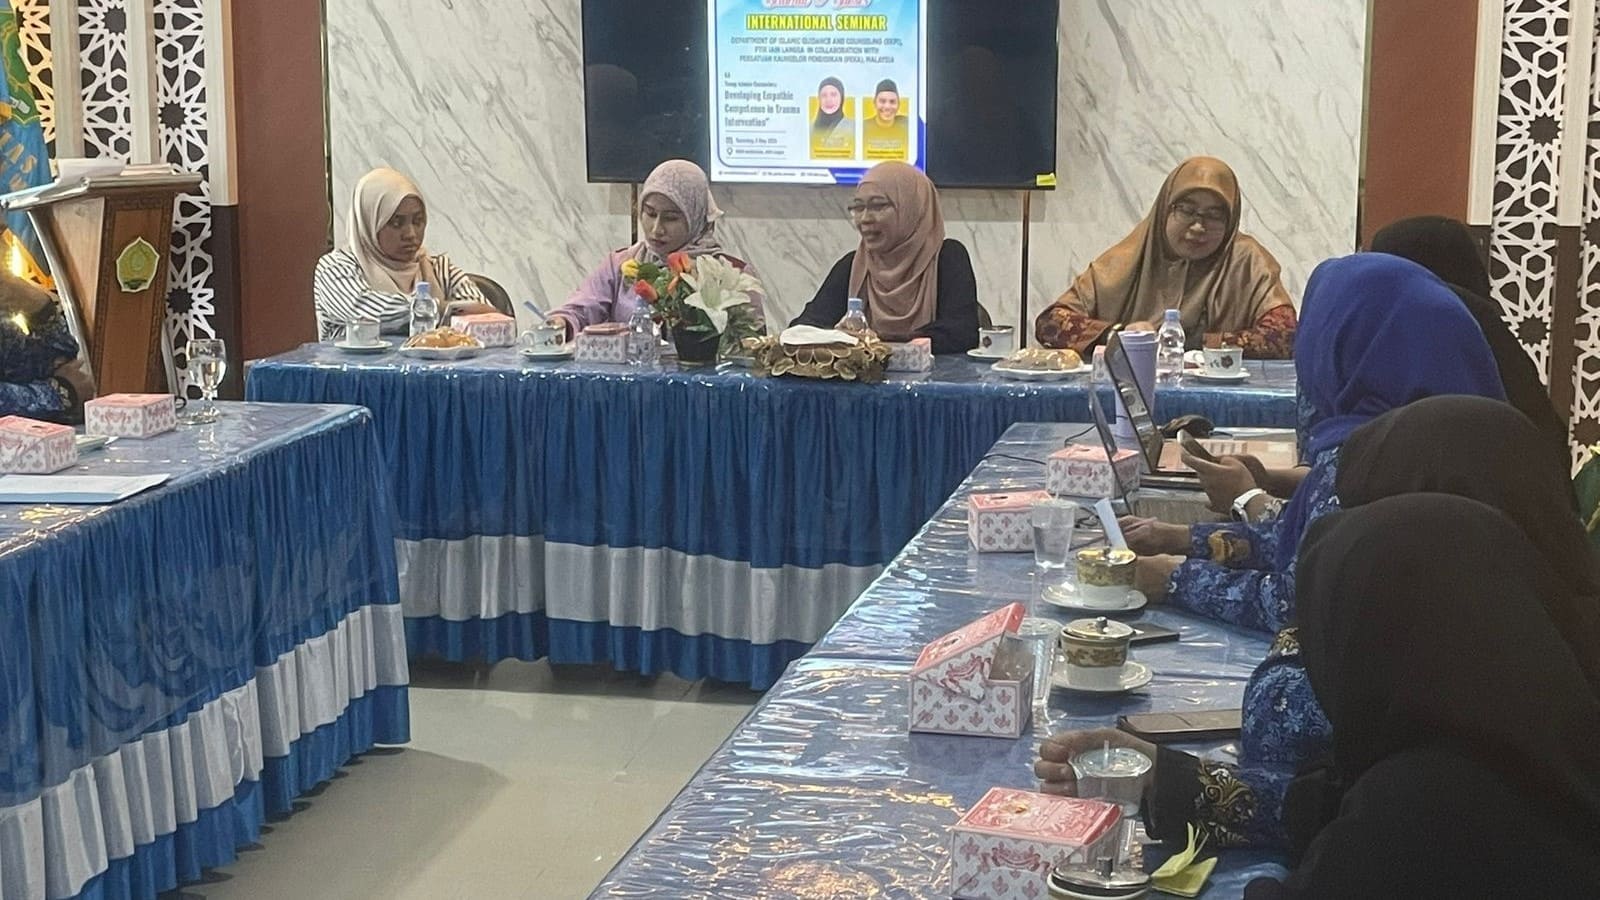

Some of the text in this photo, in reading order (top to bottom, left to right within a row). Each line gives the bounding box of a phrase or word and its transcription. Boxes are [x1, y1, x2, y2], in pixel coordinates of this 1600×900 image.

[746, 14, 888, 31] INTERNATIONAL SEMINAR
[769, 37, 777, 45] OF
[724, 90, 761, 102] Developing
